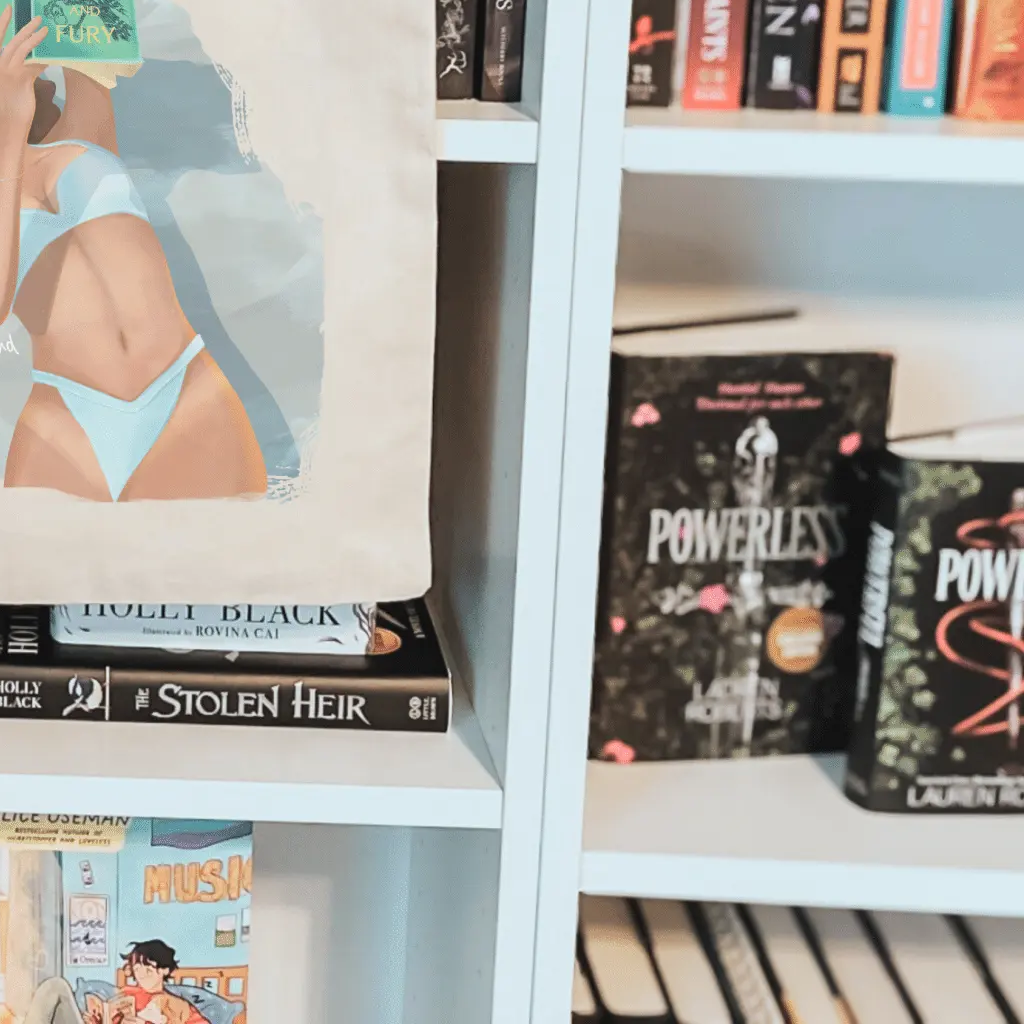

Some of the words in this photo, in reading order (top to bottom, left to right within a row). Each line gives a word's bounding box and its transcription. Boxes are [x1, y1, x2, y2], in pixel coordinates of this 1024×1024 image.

[70, 5, 101, 17] AND
[56, 24, 117, 44] FURY
[647, 506, 846, 564] POWERLESS
[195, 626, 249, 639] ROVINA
[254, 628, 279, 639] CAI
[135, 688, 150, 710] THE
[152, 683, 280, 719] STOLEN
[291, 679, 372, 725] HEIR
